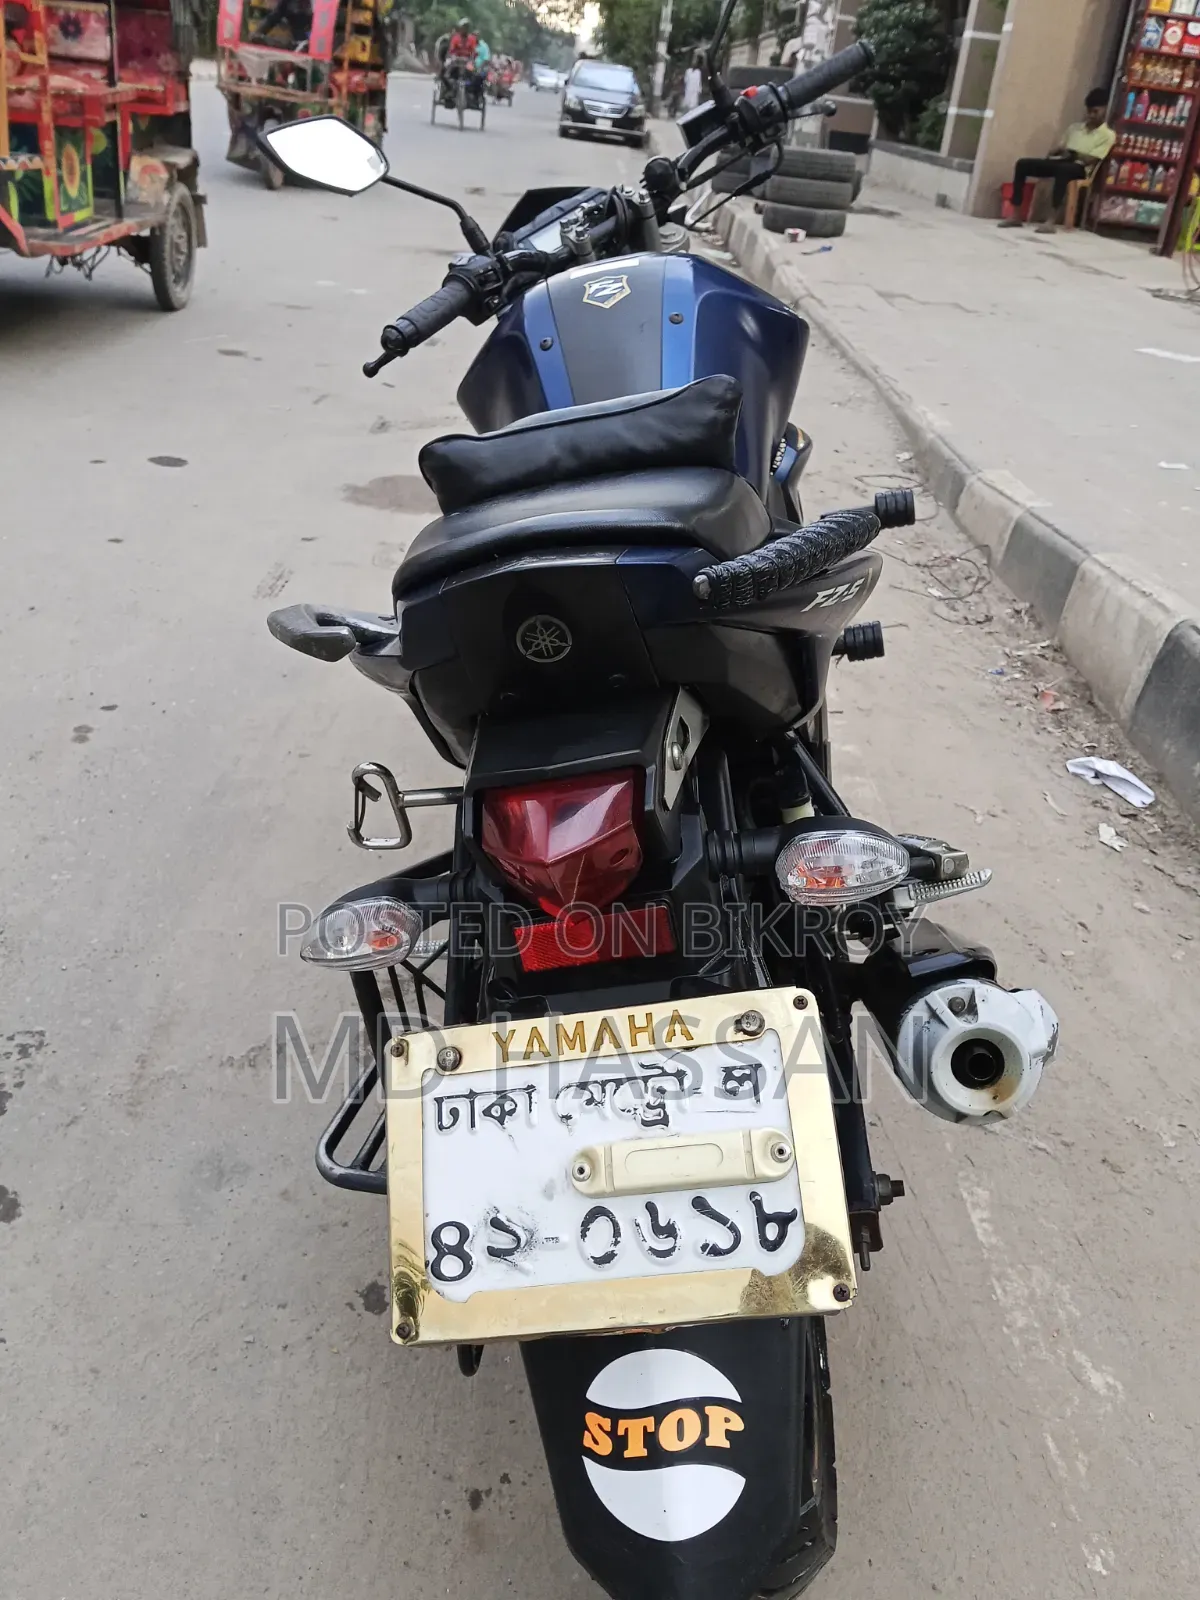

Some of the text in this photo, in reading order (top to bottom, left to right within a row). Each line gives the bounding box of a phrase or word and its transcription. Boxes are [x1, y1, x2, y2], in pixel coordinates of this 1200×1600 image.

[492, 1009, 694, 1062] YAMAHA
[433, 1084, 537, 1132] ঢাকা
[583, 1405, 745, 1459] STOP
